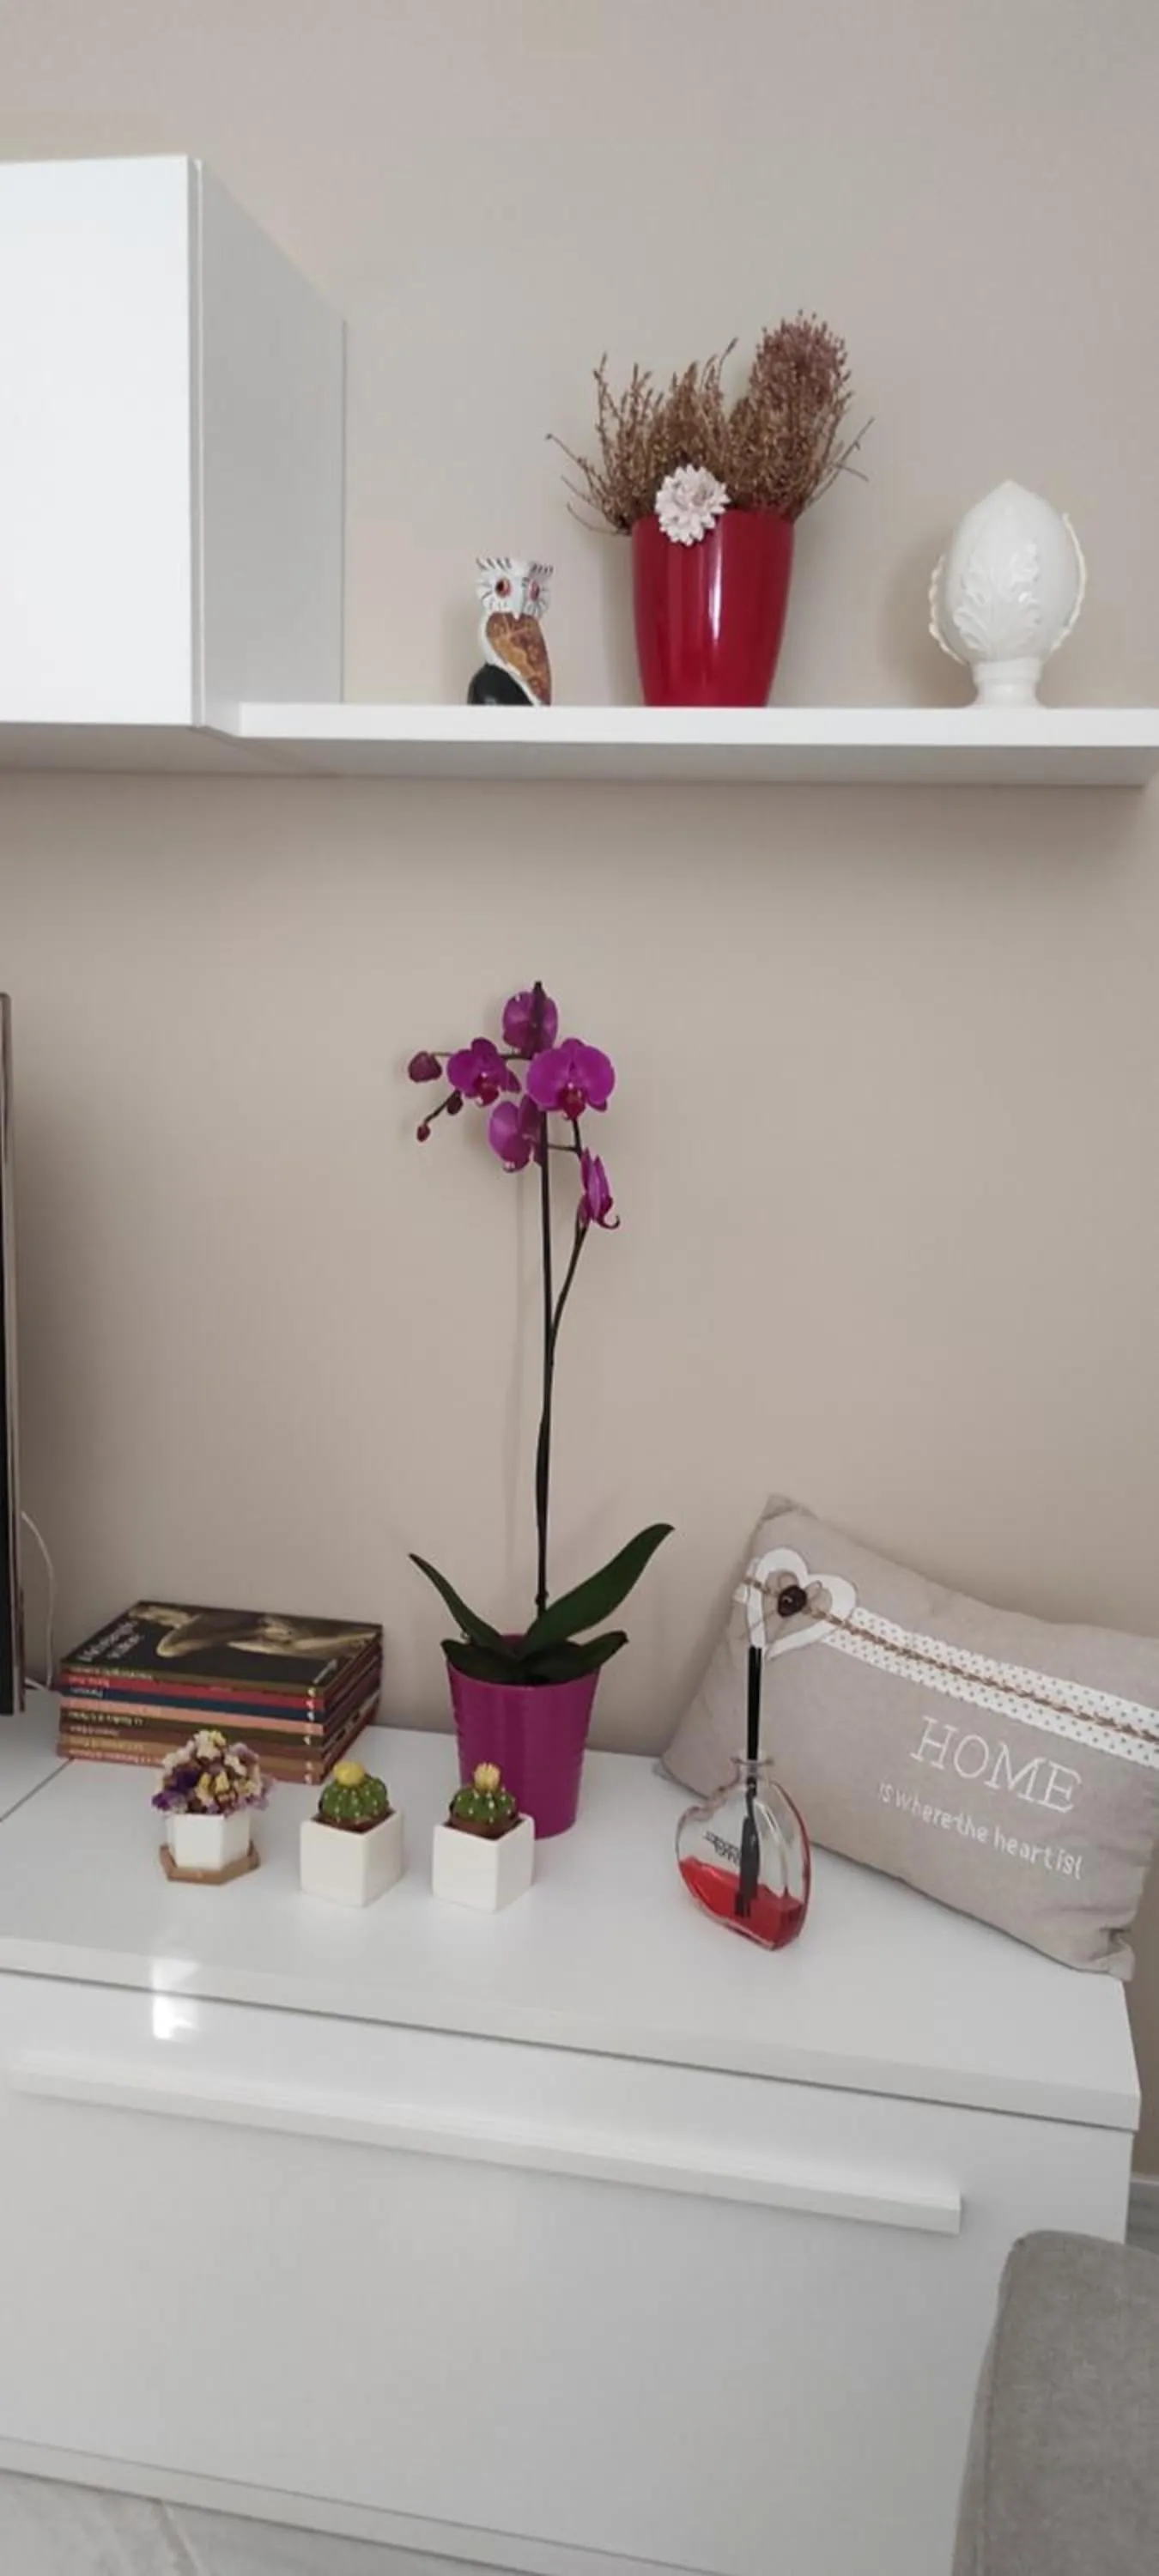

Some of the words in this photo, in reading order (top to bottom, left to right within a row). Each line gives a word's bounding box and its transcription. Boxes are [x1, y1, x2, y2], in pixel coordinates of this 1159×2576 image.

[910, 1716, 1082, 1814] HOME
[895, 1791, 951, 1830] where
[953, 1813, 988, 1843] the
[993, 1826, 1052, 1869] heart
